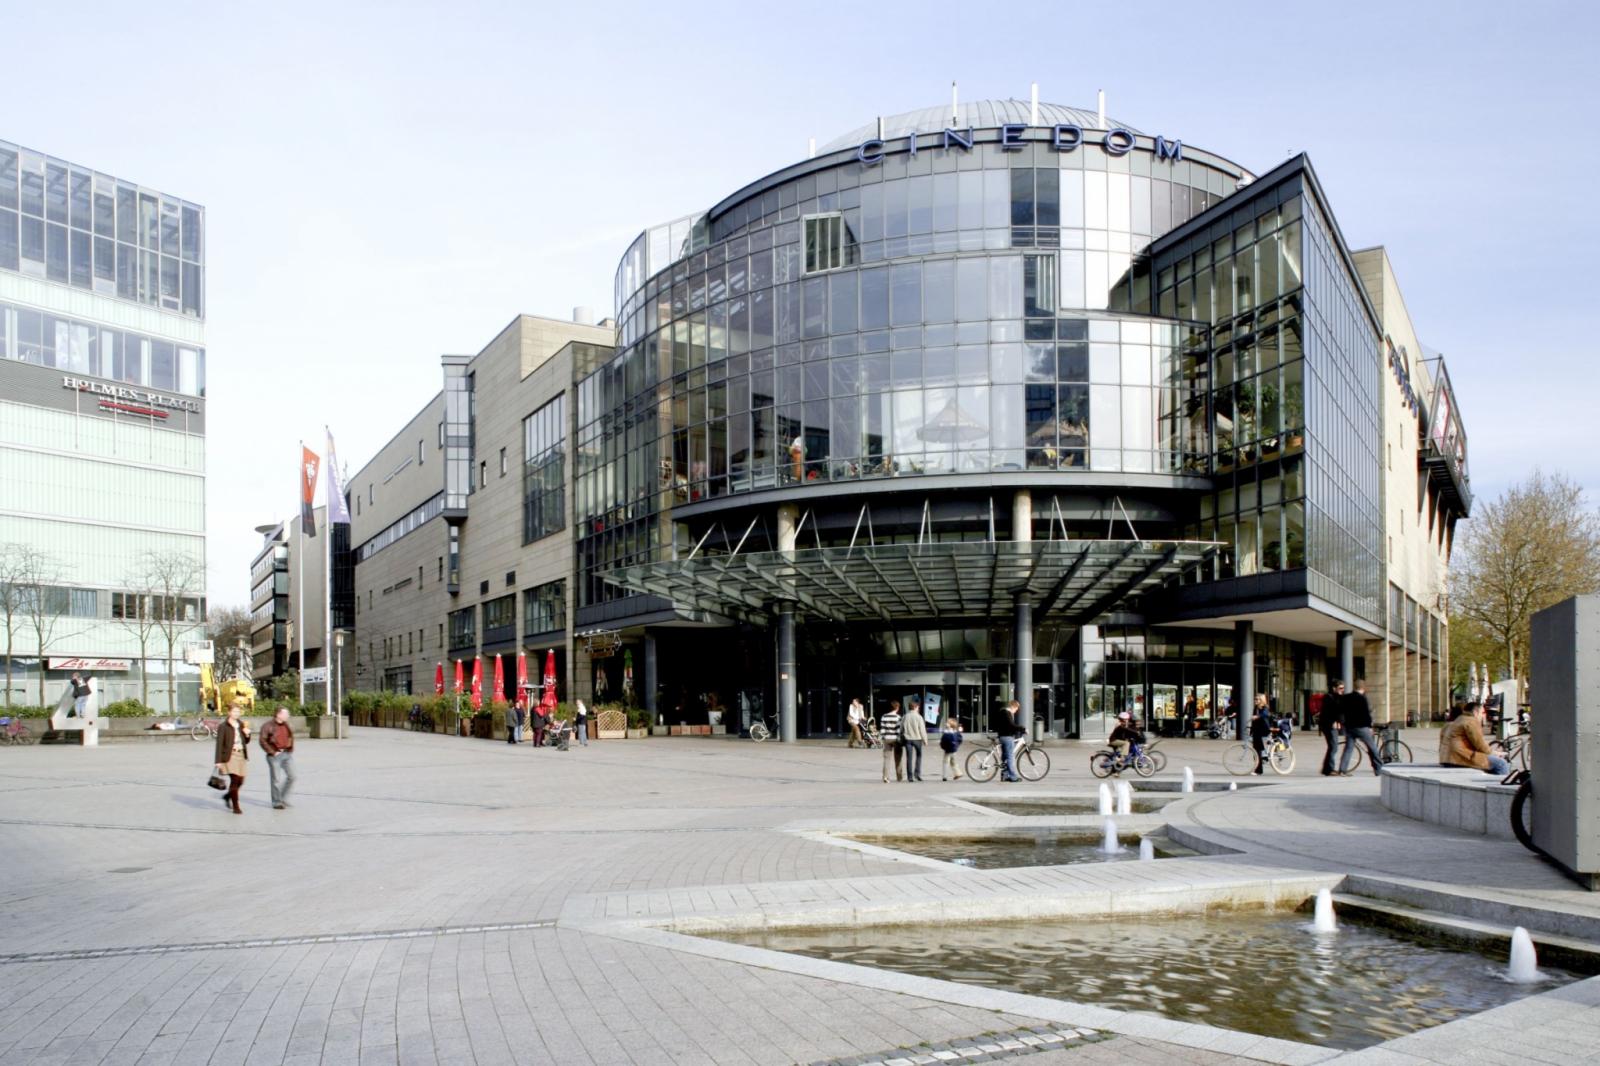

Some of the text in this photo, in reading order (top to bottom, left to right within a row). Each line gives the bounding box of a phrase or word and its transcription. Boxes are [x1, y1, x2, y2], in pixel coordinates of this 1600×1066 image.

[857, 123, 1183, 165] CINEDOM
[62, 376, 139, 400] HOLMES
[146, 392, 201, 414] PLACE
